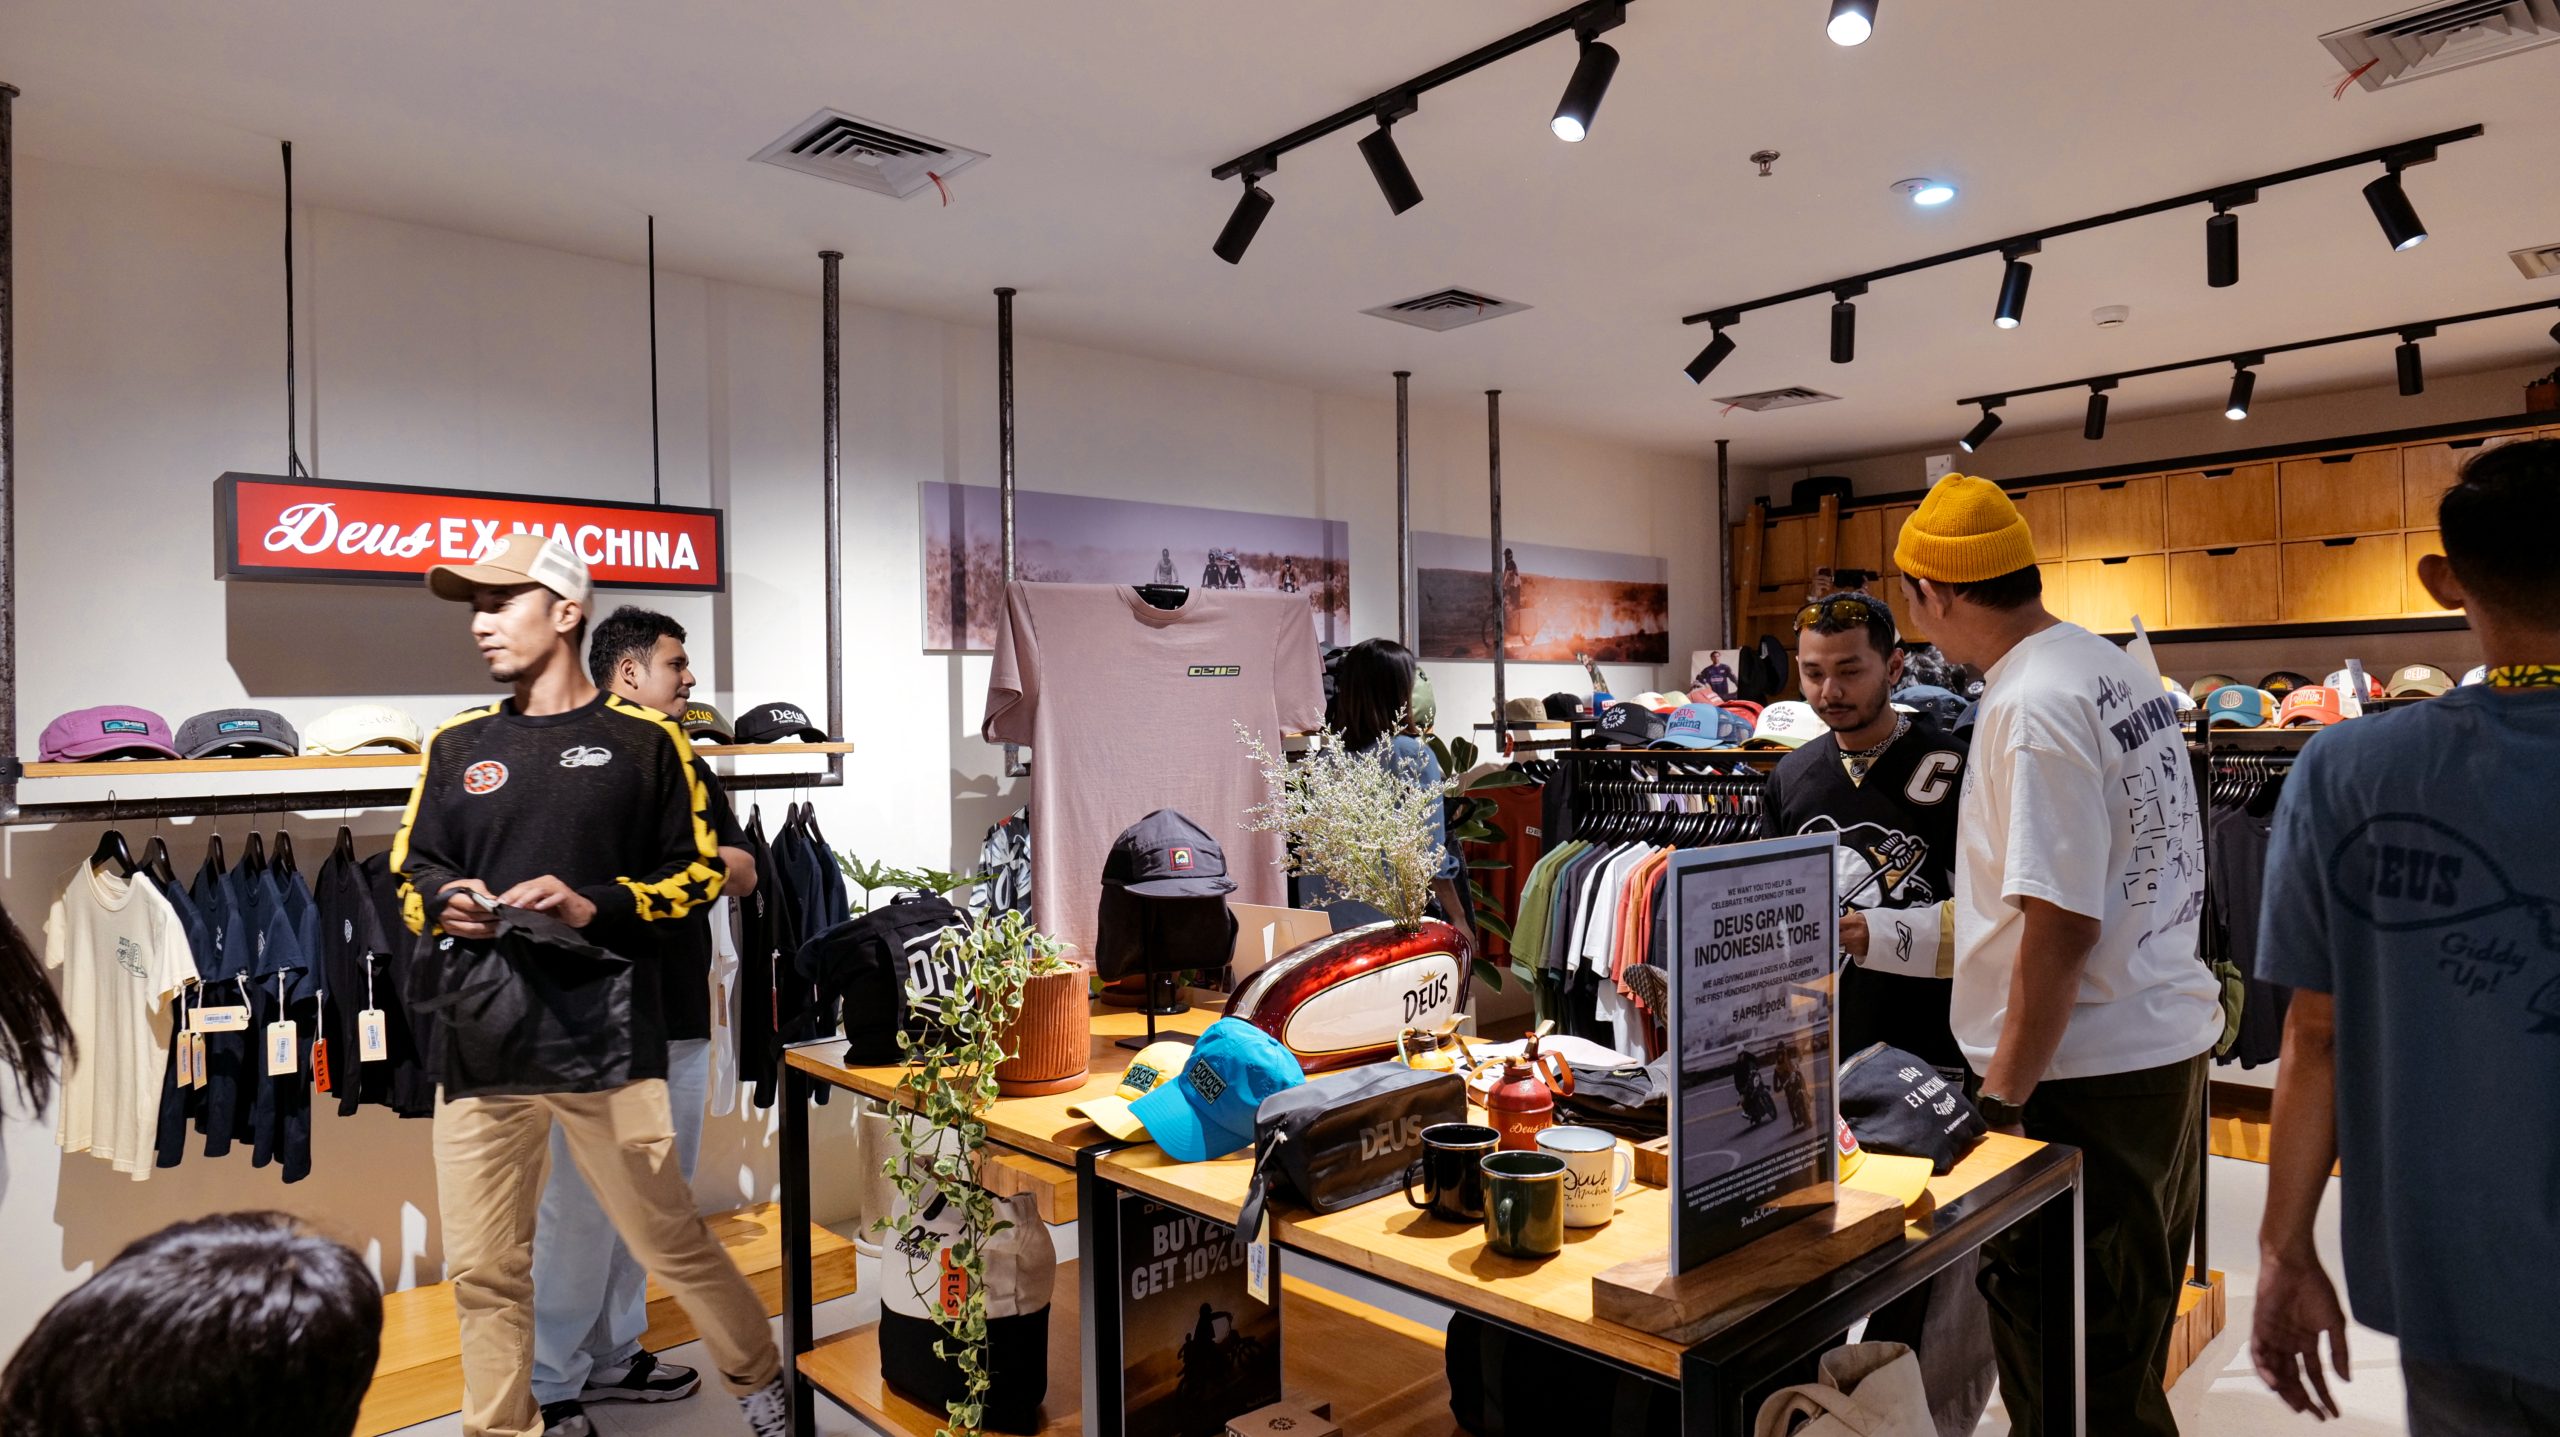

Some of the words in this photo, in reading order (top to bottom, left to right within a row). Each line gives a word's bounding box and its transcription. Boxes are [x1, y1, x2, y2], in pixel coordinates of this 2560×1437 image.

[263, 502, 435, 557] Deus
[440, 517, 500, 558] EX
[1189, 666, 1240, 677] DEUS
[2404, 667, 2431, 681] DEUS
[681, 709, 714, 723] eus
[769, 708, 807, 723] Deus
[1674, 708, 1696, 720] DEUS
[1904, 750, 1963, 806] C
[1728, 888, 1736, 897] WE
[1737, 886, 1752, 896] WANT
[1753, 884, 1764, 893] YOU
[1764, 882, 1772, 891] TO
[1772, 880, 1785, 889] HELP
[1786, 878, 1793, 887] US
[2368, 844, 2463, 907] EUS
[1711, 898, 1743, 910] CELEBRATE
[1743, 896, 1754, 905] THE
[1754, 891, 1777, 903] OPENING
[1778, 890, 1784, 899] OF
[1785, 888, 1795, 897] THE
[1795, 886, 1807, 895] NEW
[1714, 912, 1754, 939] DEUS
[1756, 903, 1805, 930] GRAND
[1694, 931, 1775, 968] INDONESIA
[1777, 921, 1820, 949] STORE
[2440, 932, 2529, 976] Giddy
[1695, 995, 1707, 1005] THE
[1707, 991, 1723, 1003] FIRST
[1724, 984, 1751, 997] HUNDRED
[1751, 977, 1783, 992] PURCHASES
[1783, 972, 1798, 982] MADE
[1798, 969, 1811, 980] HERE
[1812, 966, 1820, 976] ON
[1702, 981, 1713, 990] WE
[1713, 977, 1725, 987] ARE
[1725, 973, 1744, 985] GIVING
[1744, 970, 1760, 980] AWAY
[1764, 964, 1778, 975] DEUS
[1779, 958, 1803, 971] VOCHER
[2439, 958, 2504, 997] Up!
[1403, 972, 1449, 1024] DEUS
[1732, 1009, 1739, 1023] 5
[1740, 1005, 1764, 1020] APRIL
[1765, 996, 1786, 1013] 2024
[316, 1050, 326, 1087] DEUS
[1898, 1066, 1923, 1083] DEUS
[1904, 1091, 1926, 1109] EX
[1359, 1113, 1423, 1162] DEUS
[1509, 1122, 1539, 1135] Deus
[1153, 1217, 1200, 1257] BUY
[1132, 1256, 1178, 1300] GET
[1184, 1240, 1228, 1283] 10%
